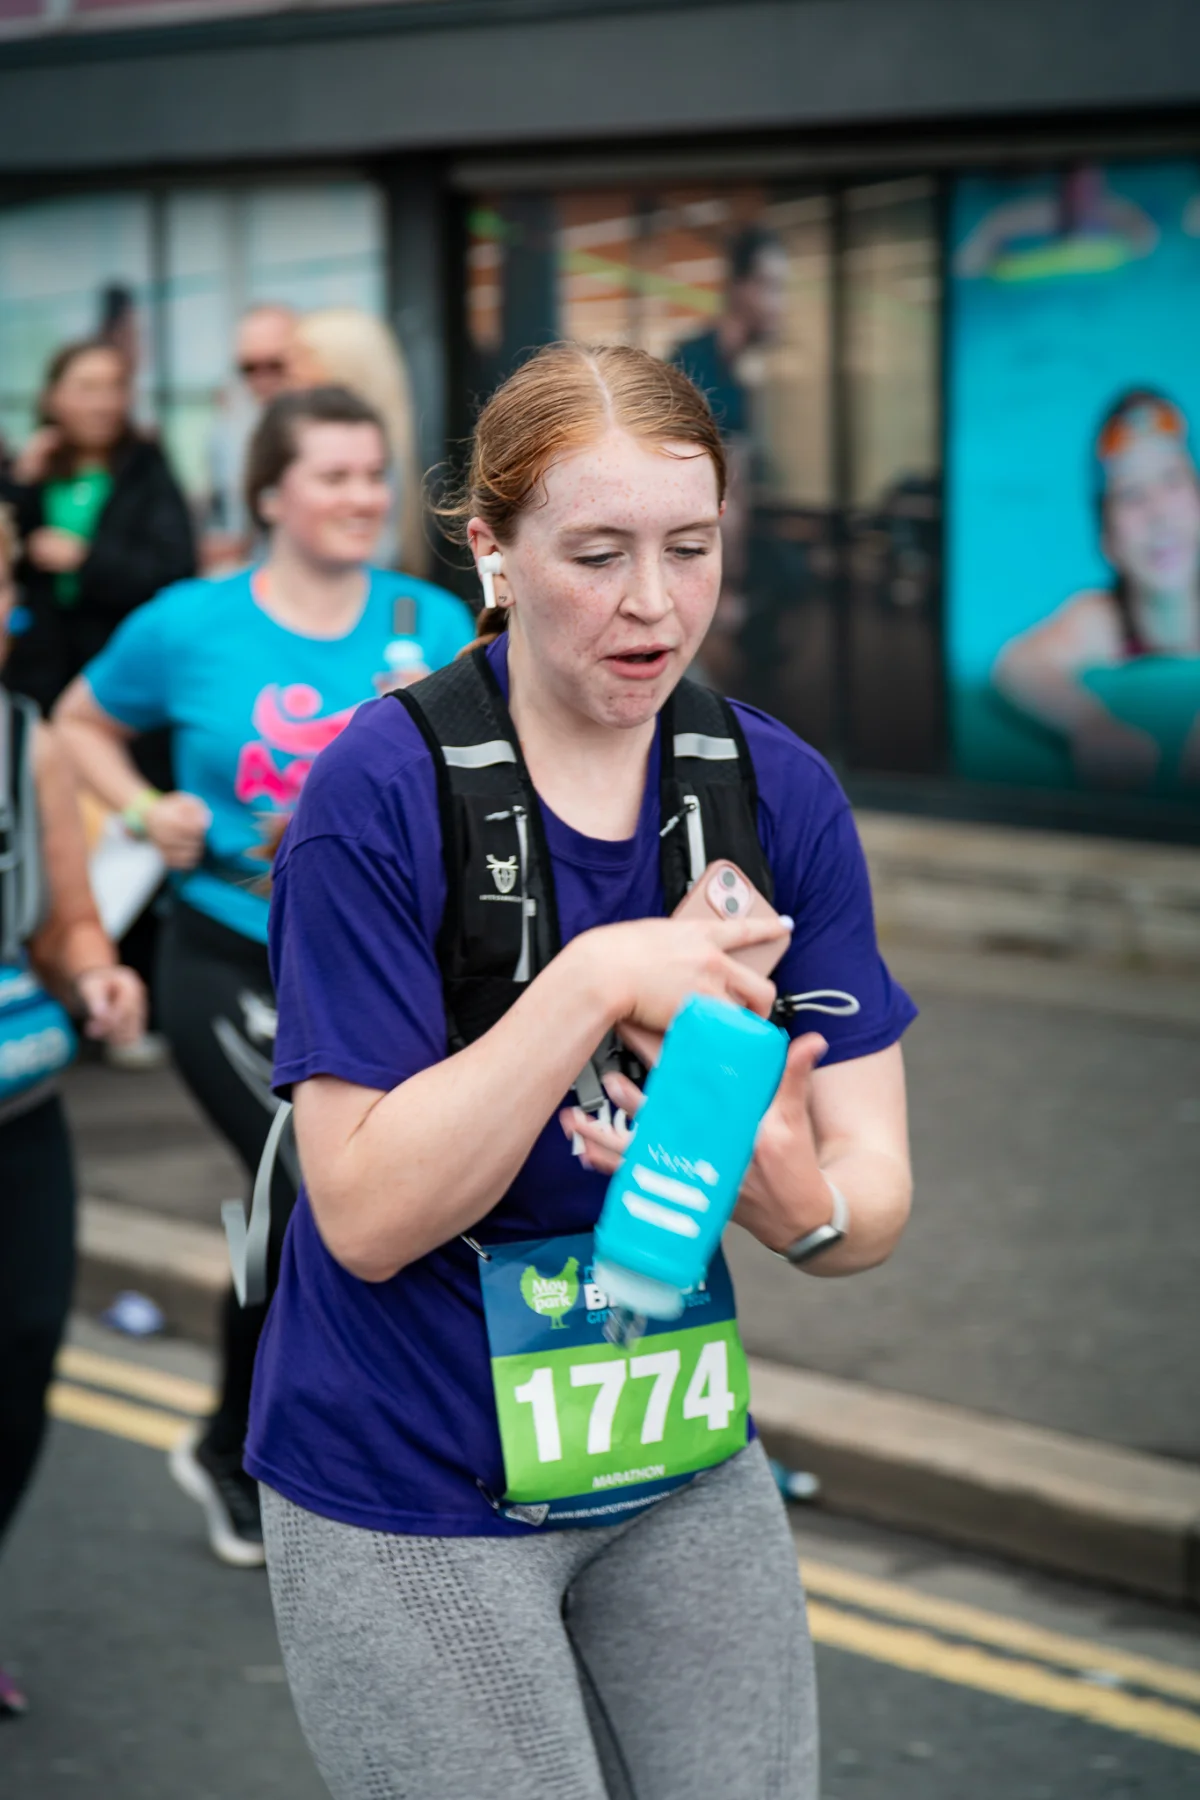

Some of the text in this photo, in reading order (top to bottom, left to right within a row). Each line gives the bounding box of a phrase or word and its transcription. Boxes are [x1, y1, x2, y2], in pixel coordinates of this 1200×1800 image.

[532, 1279, 568, 1298] Moy
[532, 1295, 573, 1314] park
[514, 1340, 735, 1463] 1774
[592, 1464, 665, 1489] MARATHON
